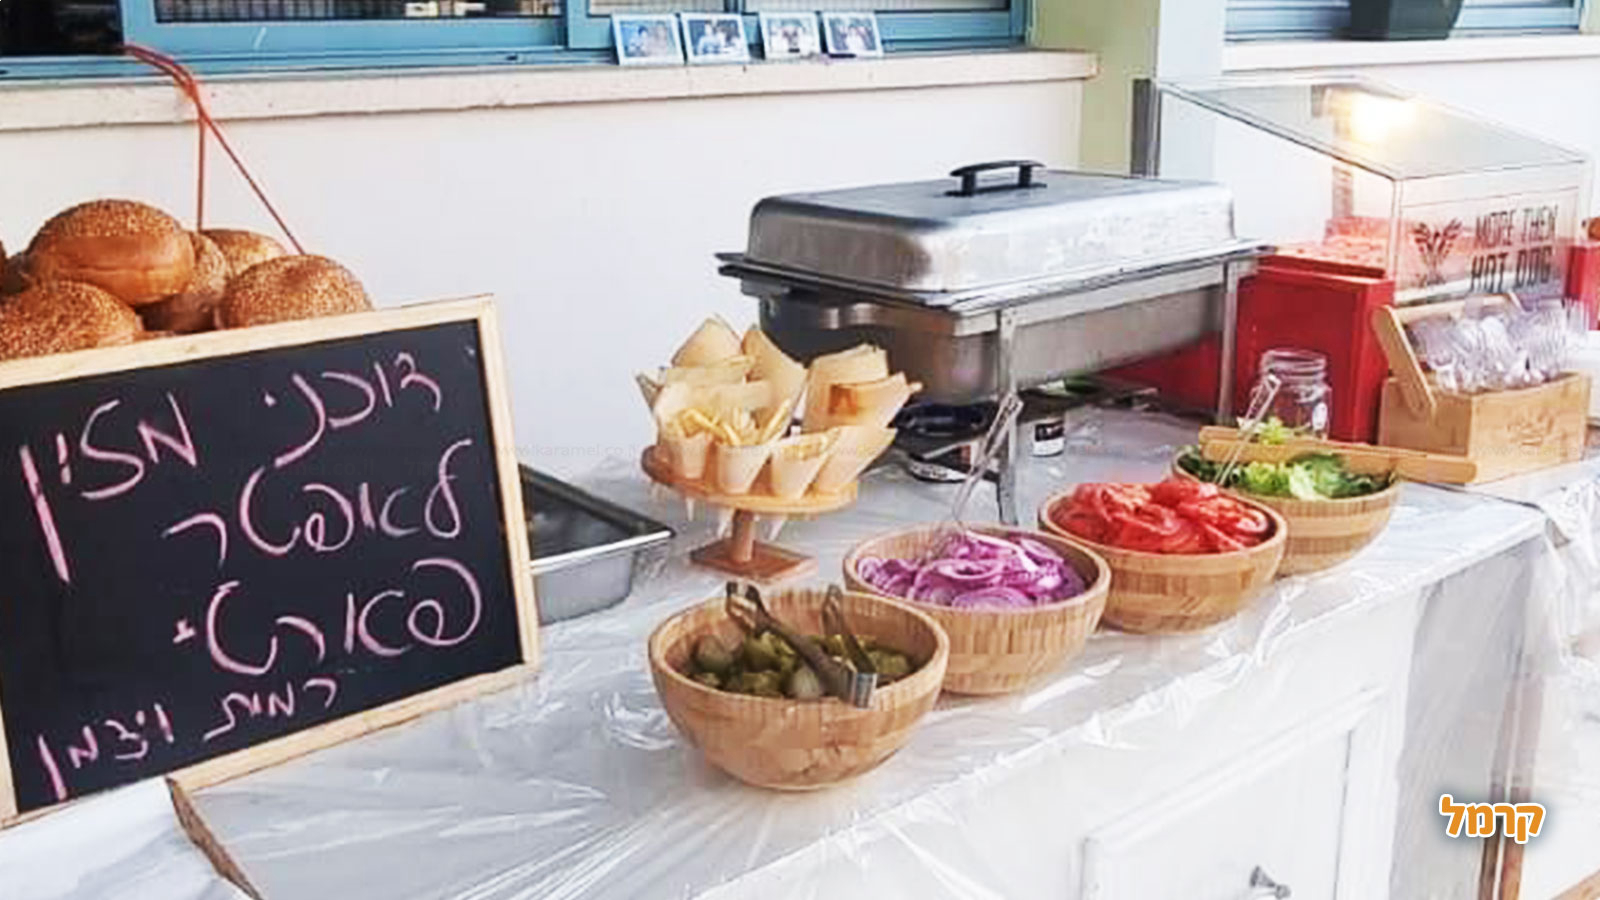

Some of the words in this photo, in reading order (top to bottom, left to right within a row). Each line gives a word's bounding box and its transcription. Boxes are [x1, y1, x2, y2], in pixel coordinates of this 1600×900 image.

[1470, 252, 1508, 294] HOT
[1515, 246, 1553, 288] DOG
[1475, 211, 1516, 250] MORE
[162, 439, 472, 566] לאפטר
[173, 557, 482, 676] פארטי
